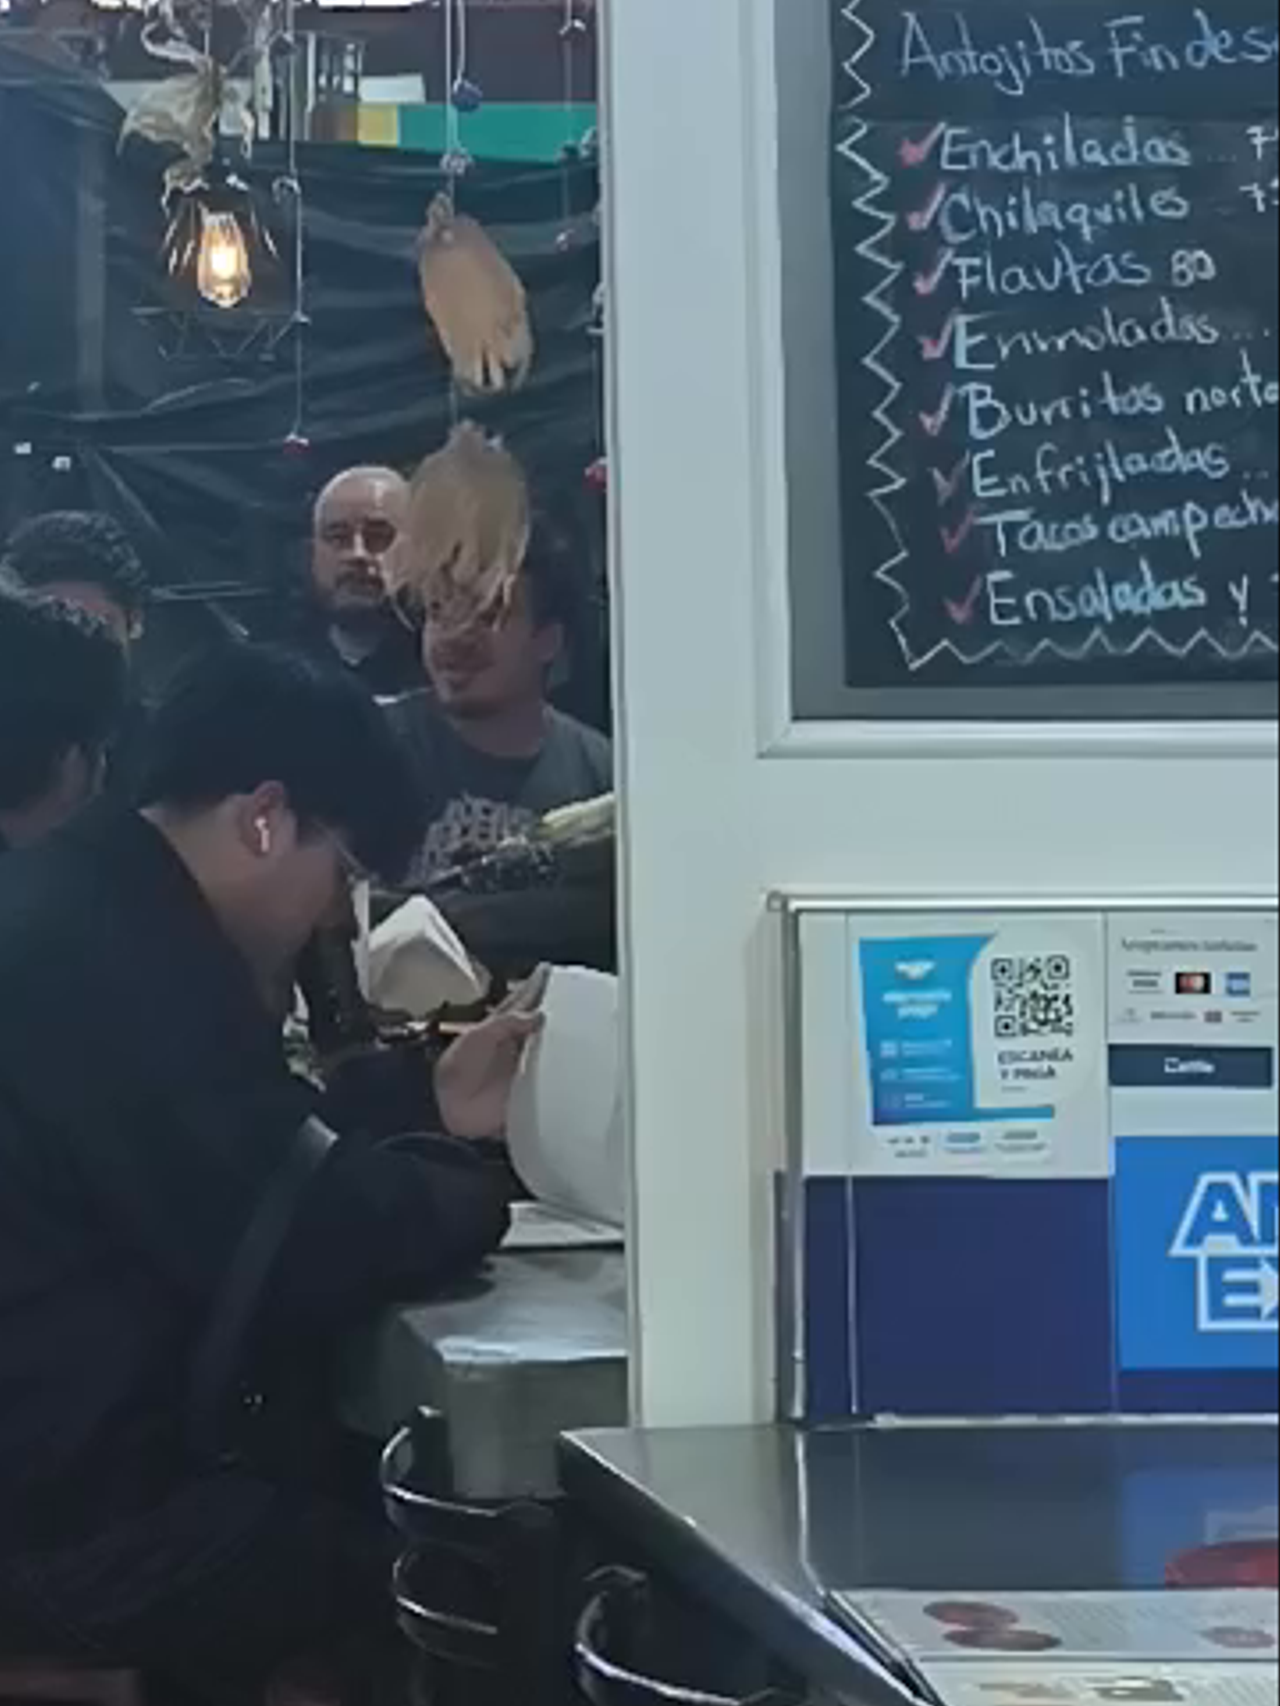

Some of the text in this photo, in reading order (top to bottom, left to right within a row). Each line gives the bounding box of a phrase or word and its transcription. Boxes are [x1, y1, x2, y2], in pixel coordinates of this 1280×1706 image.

[901, 10, 1095, 96] Antojitos
[940, 112, 1278, 176] Enchiladas 7
[940, 184, 1190, 244] Chilaquiles
[952, 240, 1217, 301] Flautas 80
[954, 296, 1219, 370] Enmoladas
[956, 370, 1165, 439] Burritos
[972, 506, 1100, 557] Tacos
[986, 557, 1206, 626] Ensaladas
